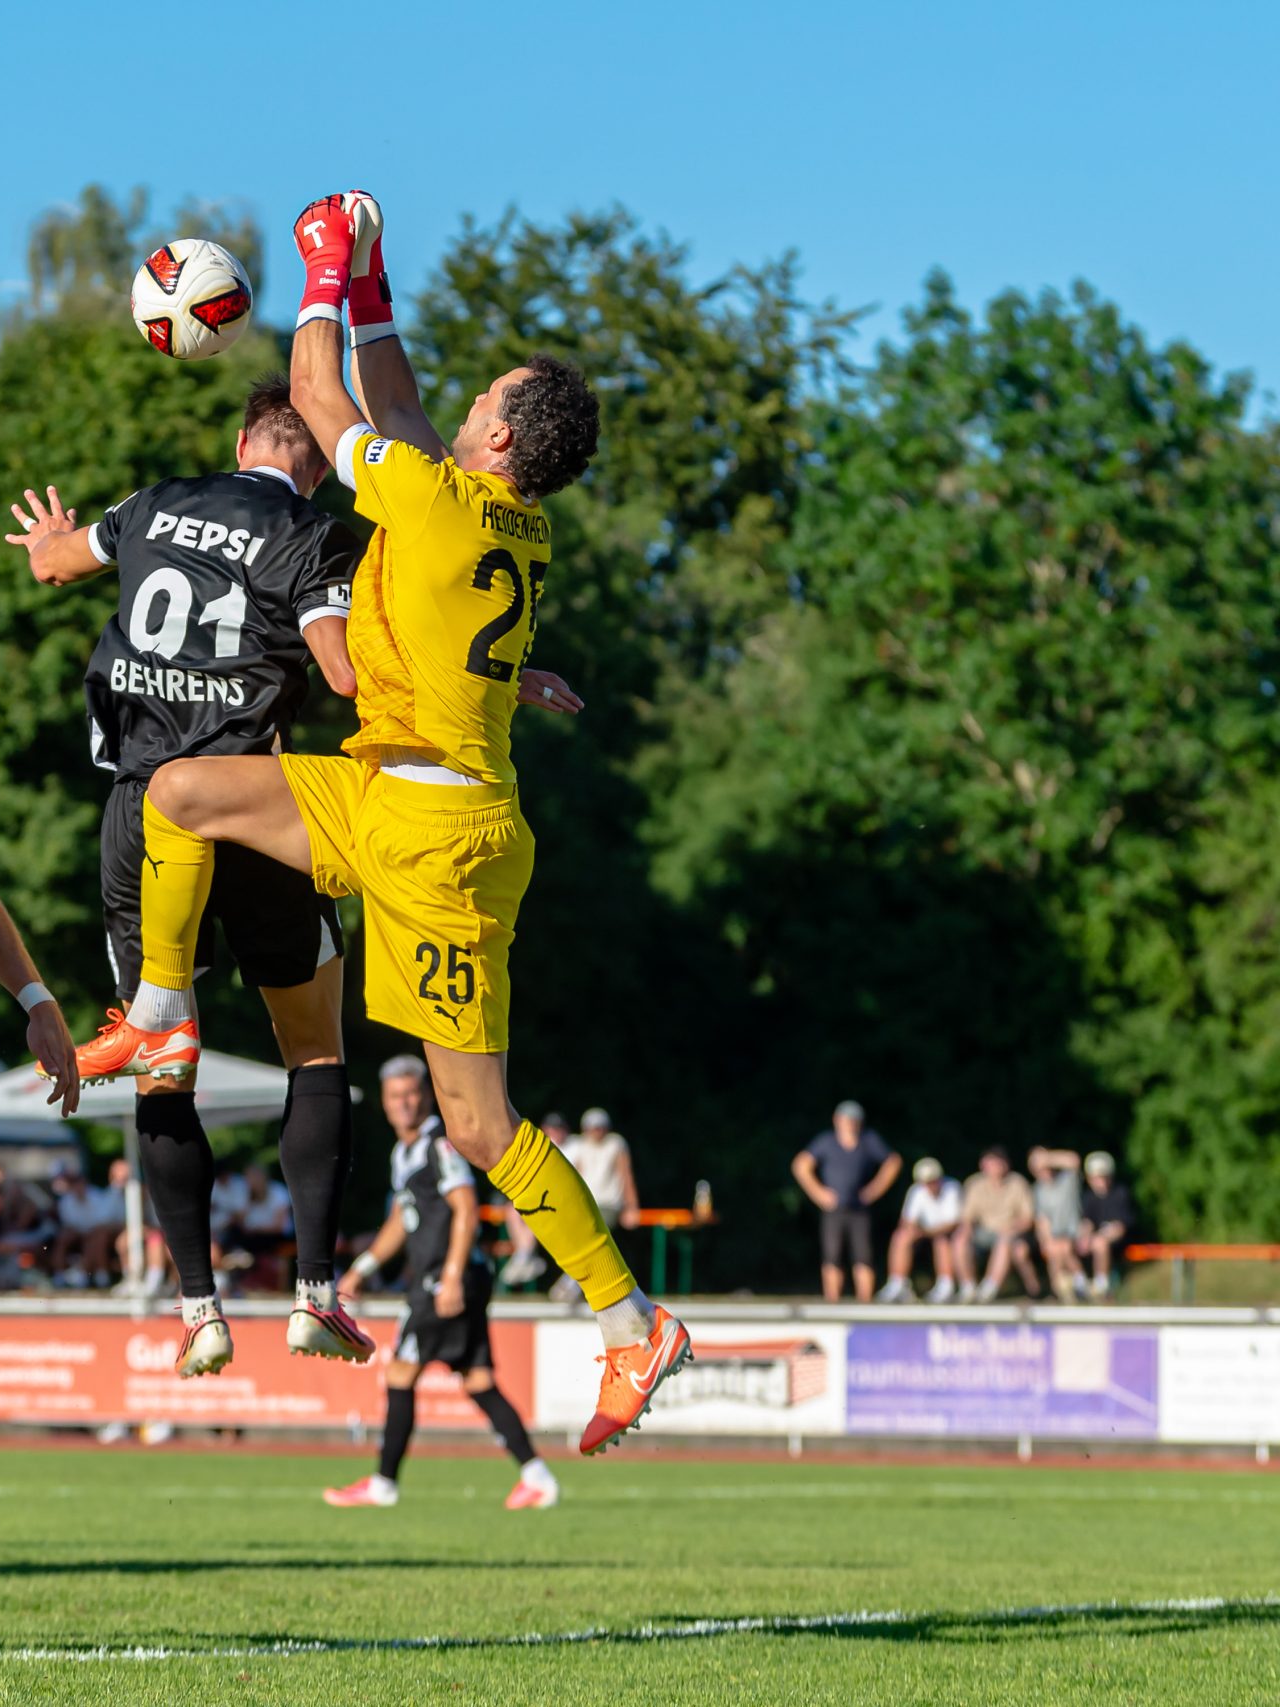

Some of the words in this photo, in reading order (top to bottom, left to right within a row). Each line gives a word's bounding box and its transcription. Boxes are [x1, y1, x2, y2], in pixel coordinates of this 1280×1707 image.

[145, 511, 266, 567] PEPSI
[110, 658, 247, 707] BEHRENS
[415, 942, 475, 1005] 25
